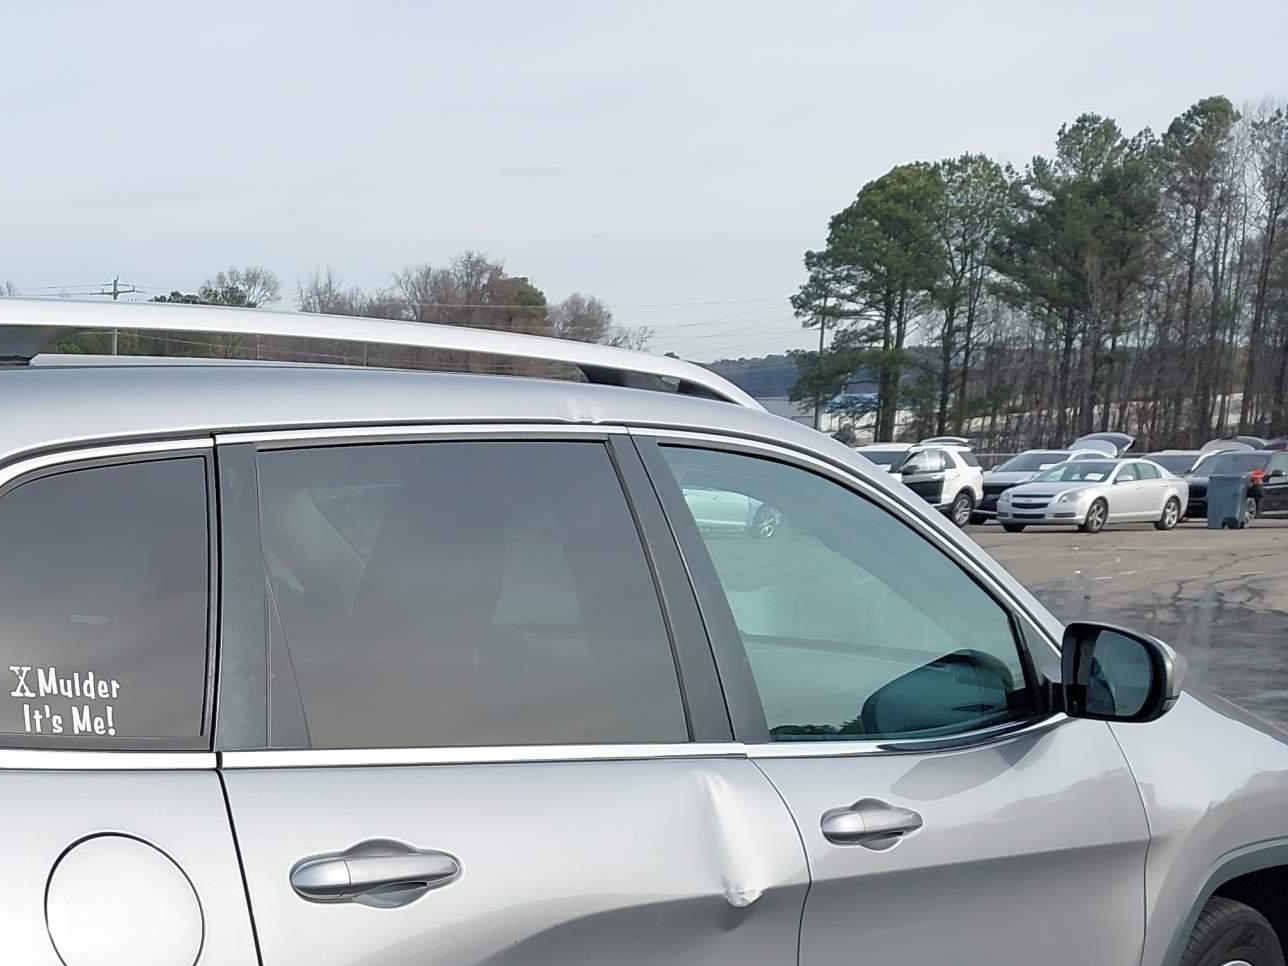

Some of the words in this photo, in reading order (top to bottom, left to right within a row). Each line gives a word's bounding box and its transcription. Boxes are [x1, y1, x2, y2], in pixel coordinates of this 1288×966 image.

[9, 666, 36, 698] X
[37, 667, 120, 699] Mulder
[23, 704, 63, 734] It's
[71, 705, 116, 736] Me!
